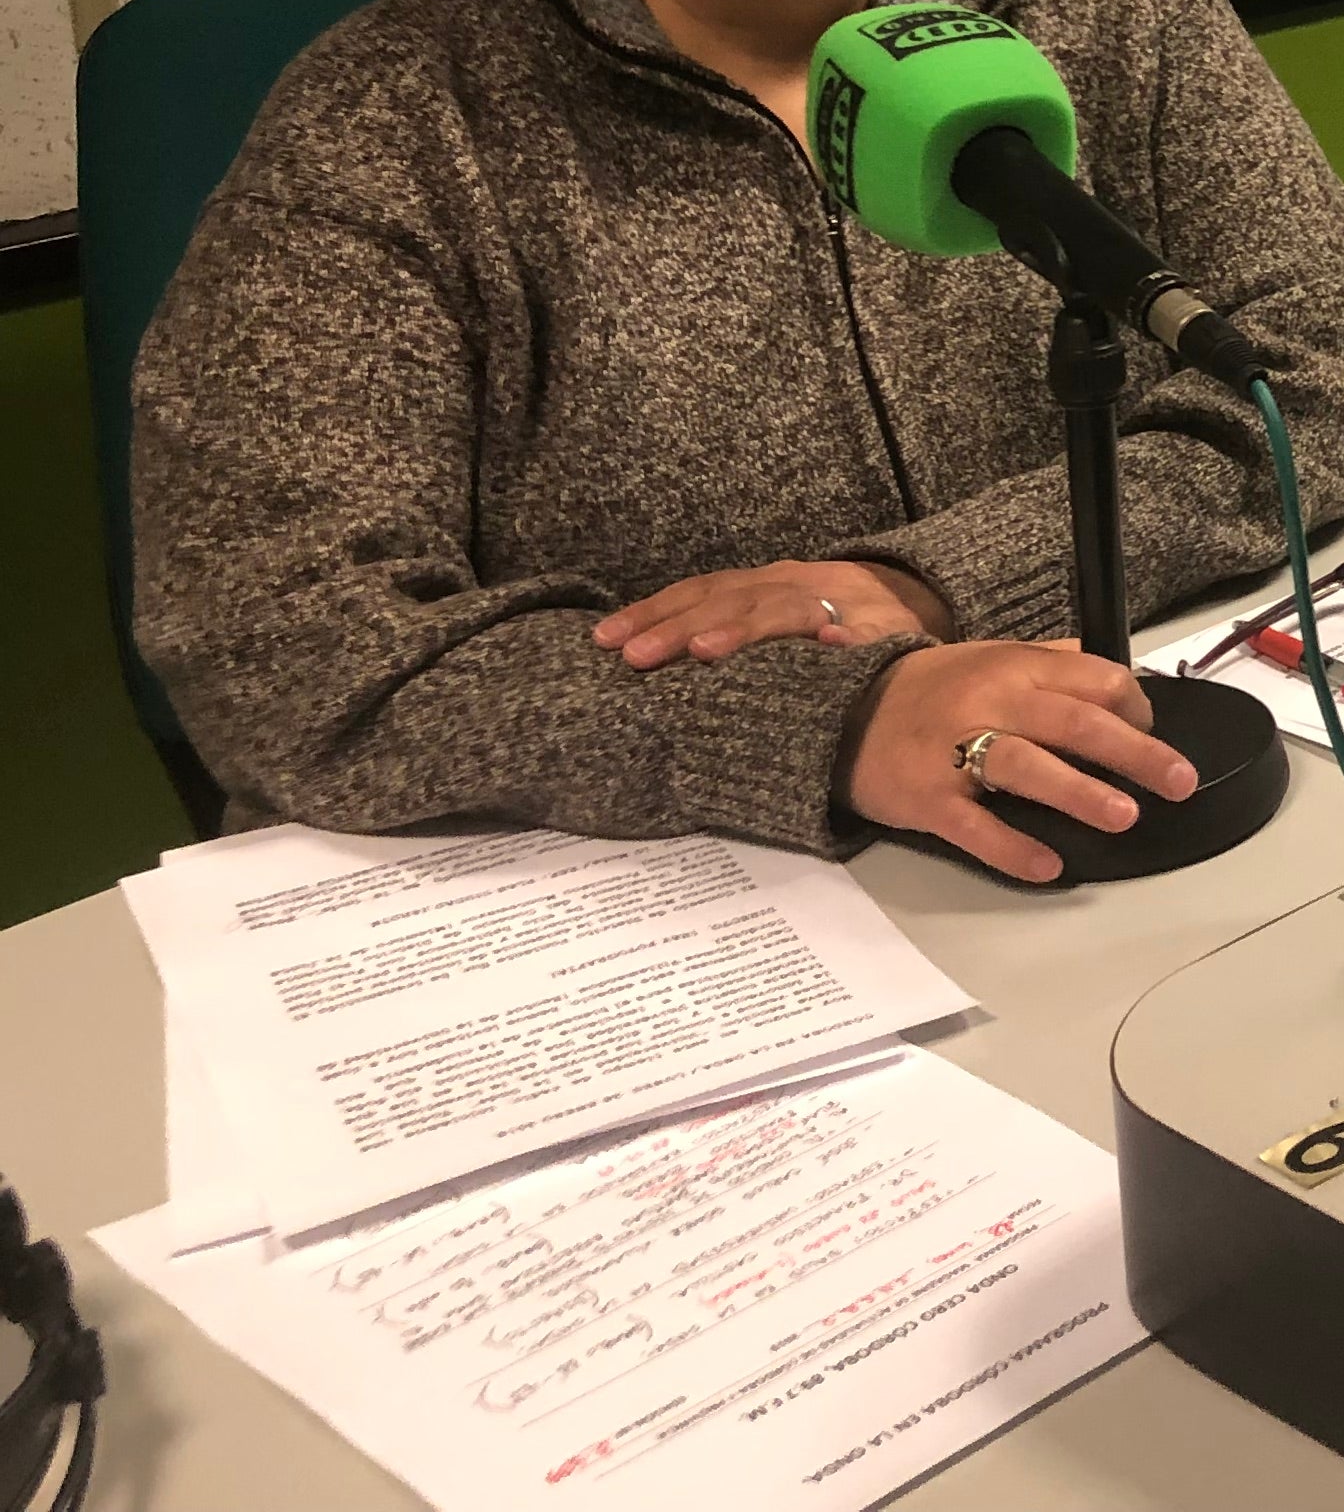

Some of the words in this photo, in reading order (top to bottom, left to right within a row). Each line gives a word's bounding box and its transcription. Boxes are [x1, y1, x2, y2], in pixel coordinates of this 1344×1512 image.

[907, 22, 990, 42] CERO
[964, 1262, 1020, 1296] ONDA
[917, 1290, 967, 1323] CERO
[1007, 1300, 1111, 1363] PROGRAMA
[919, 1358, 1010, 1417] CÓRDOBA
[865, 1429, 894, 1449] LA
[891, 1412, 923, 1434] EN
